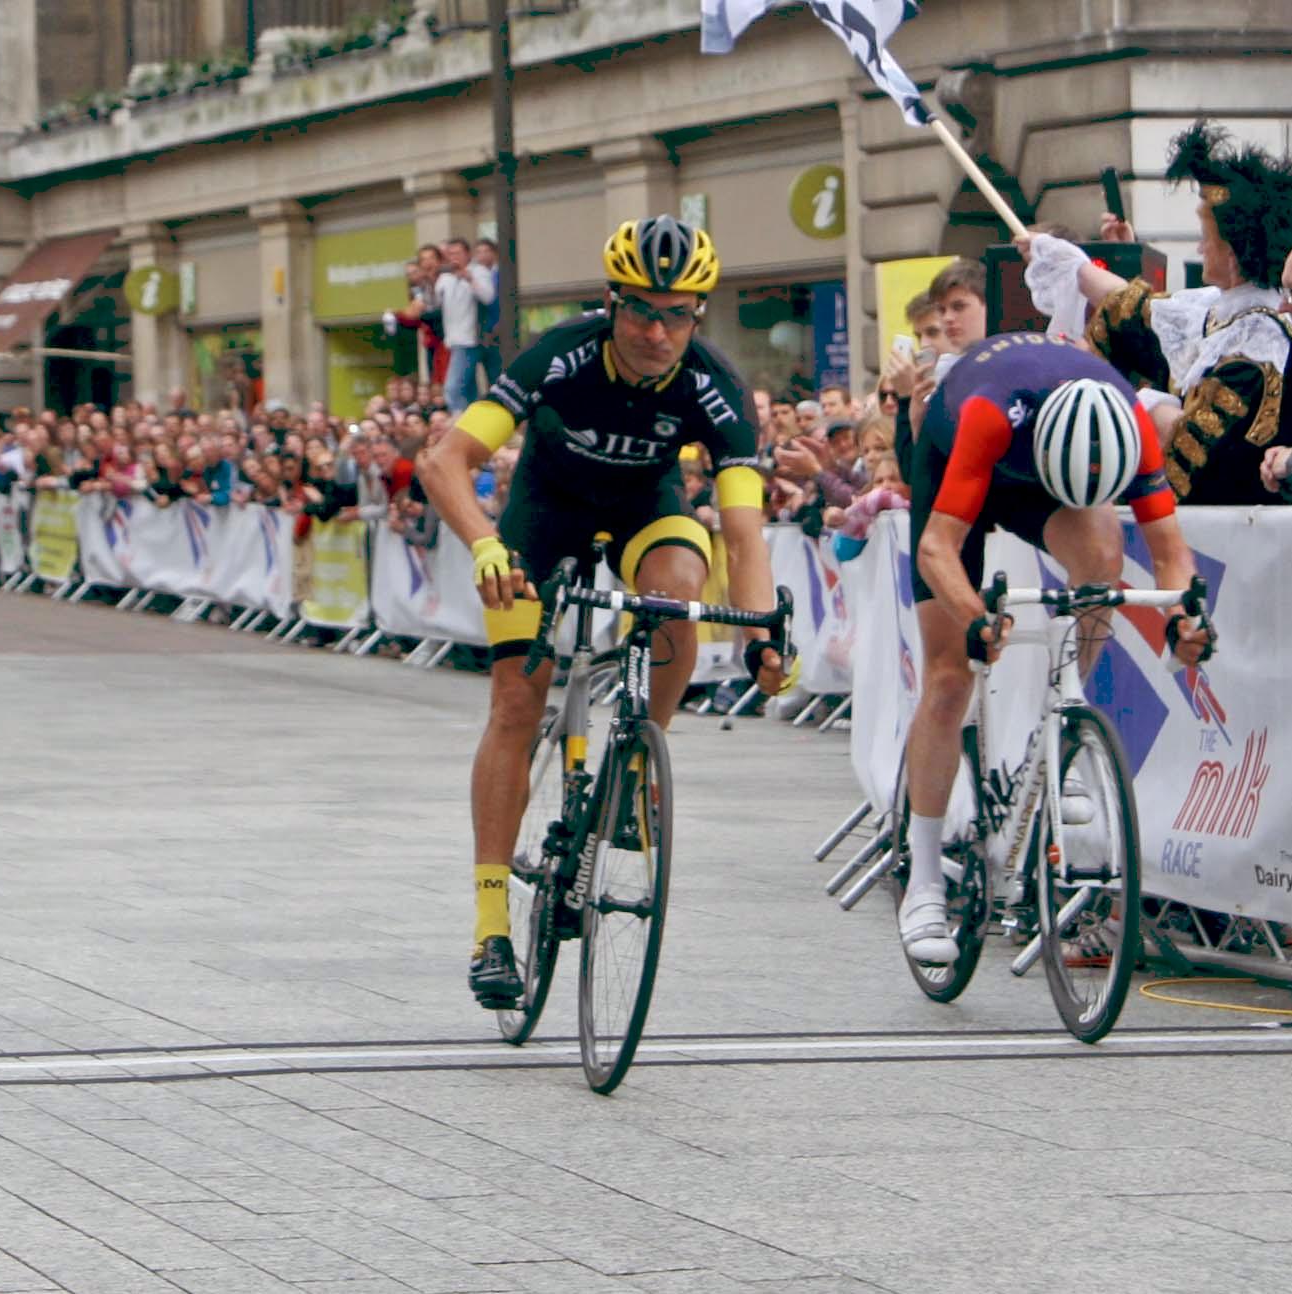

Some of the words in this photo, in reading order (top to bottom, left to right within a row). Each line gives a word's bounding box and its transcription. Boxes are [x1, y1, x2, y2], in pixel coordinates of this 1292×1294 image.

[698, 388, 738, 427] JLT
[596, 433, 668, 459] JLT
[1199, 729, 1218, 752] THE
[1172, 725, 1271, 839] milk
[564, 832, 598, 910] Condor
[1161, 838, 1204, 879] RACE
